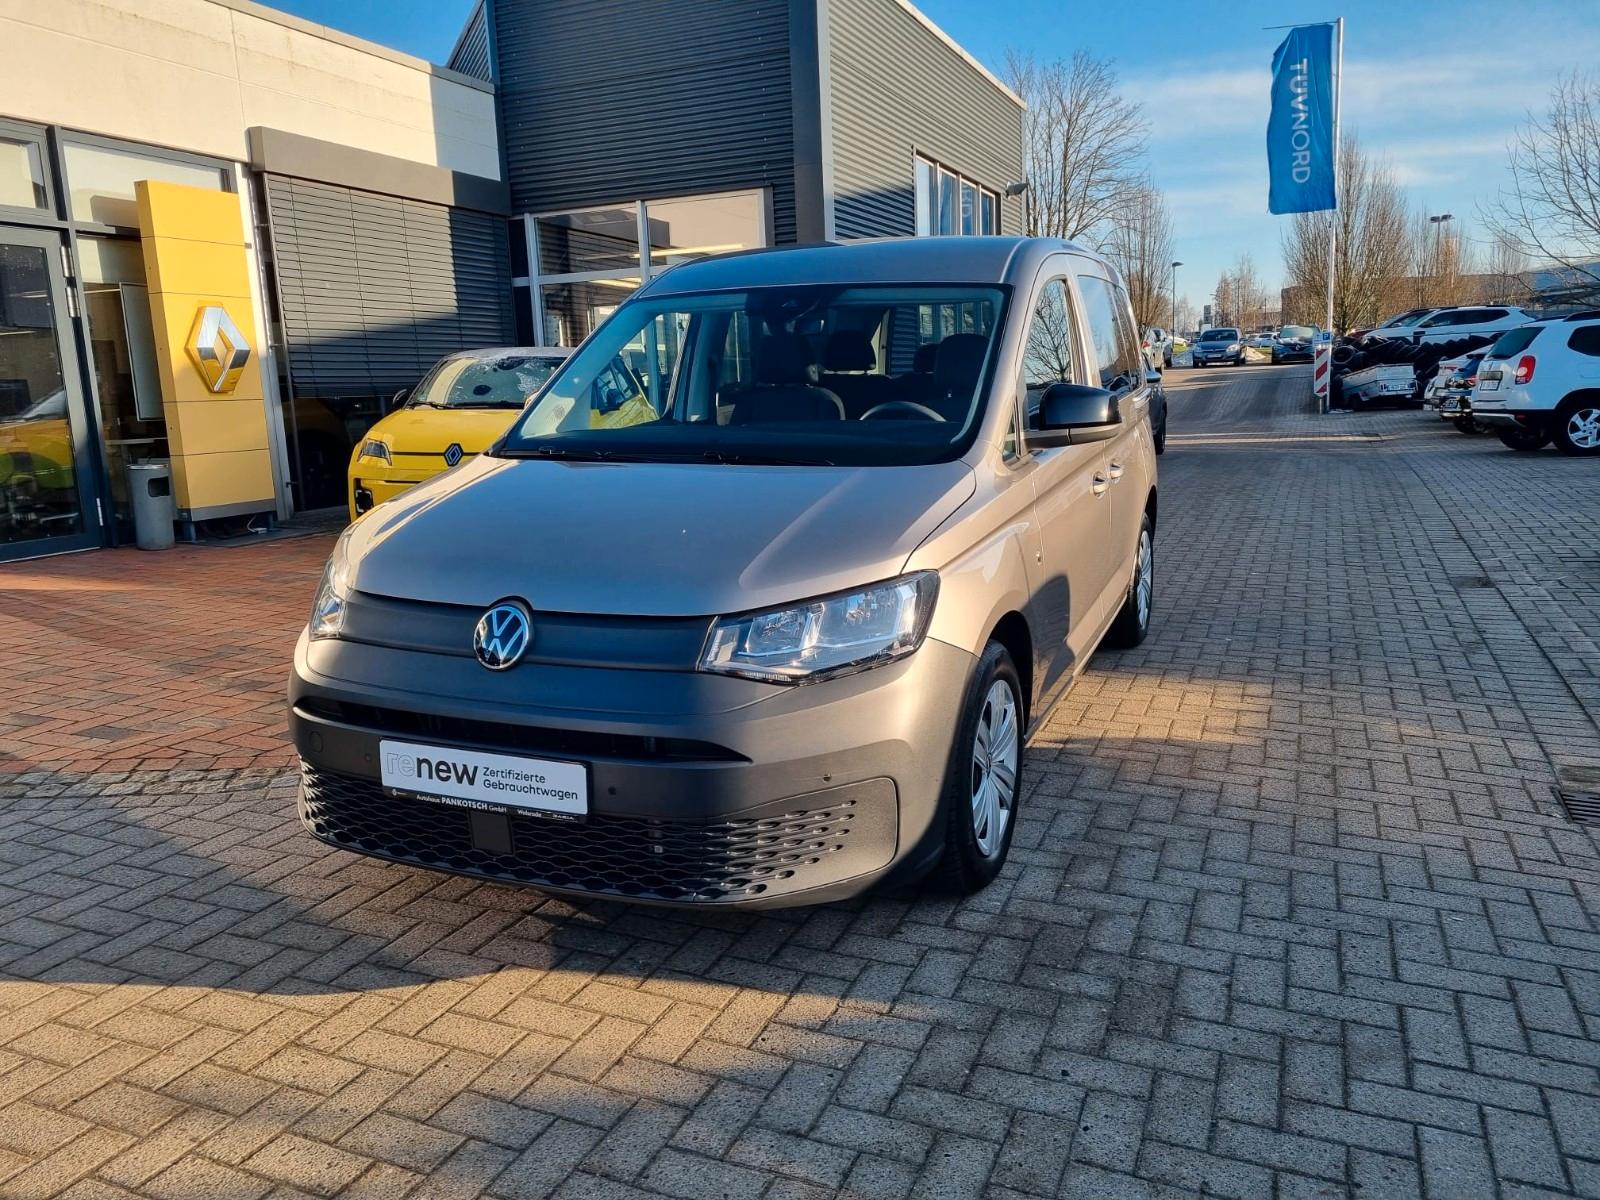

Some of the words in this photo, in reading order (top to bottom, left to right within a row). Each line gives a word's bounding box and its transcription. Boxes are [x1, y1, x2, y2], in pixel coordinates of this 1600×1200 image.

[386, 752, 479, 786] renew
[482, 766, 546, 784] Zertifizierte
[483, 779, 578, 801] Gebrauchtwagen
[441, 797, 487, 810] PANKOTSCH
